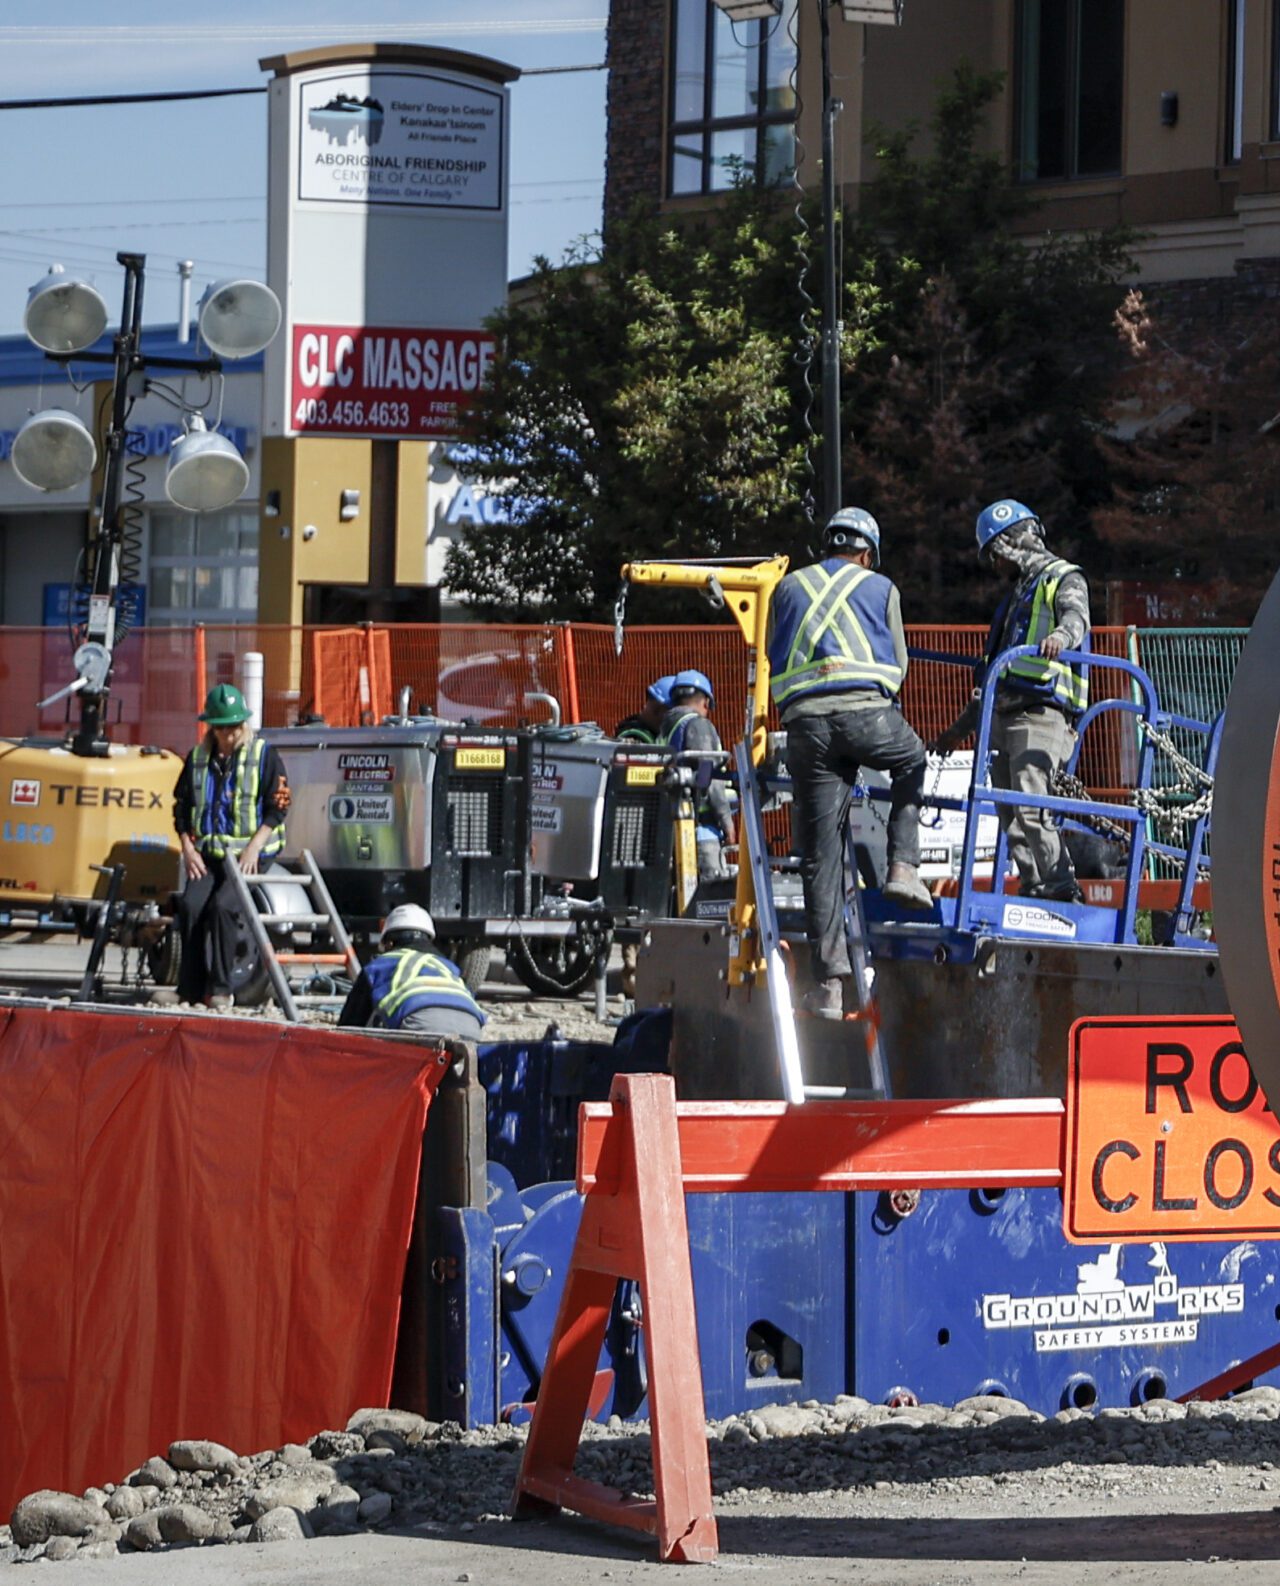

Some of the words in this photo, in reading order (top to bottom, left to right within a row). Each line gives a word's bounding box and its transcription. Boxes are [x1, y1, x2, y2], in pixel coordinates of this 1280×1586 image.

[426, 103, 449, 116] Drop
[452, 104, 462, 114] In
[454, 134, 477, 144] Place
[315, 153, 400, 168] ABORIGINAL
[405, 157, 487, 172] FRIENDSHIP
[332, 169, 384, 183] CENTRE
[388, 171, 406, 183] OF
[410, 172, 470, 187] CALGARY
[340, 184, 364, 196] Many
[404, 187, 421, 197] One
[299, 333, 354, 388] CLC
[295, 398, 410, 427] 403.456.4633
[430, 402, 458, 414] FREE
[420, 415, 462, 428] PARKIN
[340, 756, 387, 768] LINCOLN
[349, 769, 390, 780] ELECTRIC
[346, 784, 384, 792] VANTAGE
[50, 784, 164, 809] TEREX
[356, 798, 388, 810] United
[356, 808, 390, 820] Rentals
[1145, 1041, 1272, 1114] RO
[1038, 1331, 1103, 1347] SAFETY
[1120, 1324, 1196, 1340] SYSTEMS
